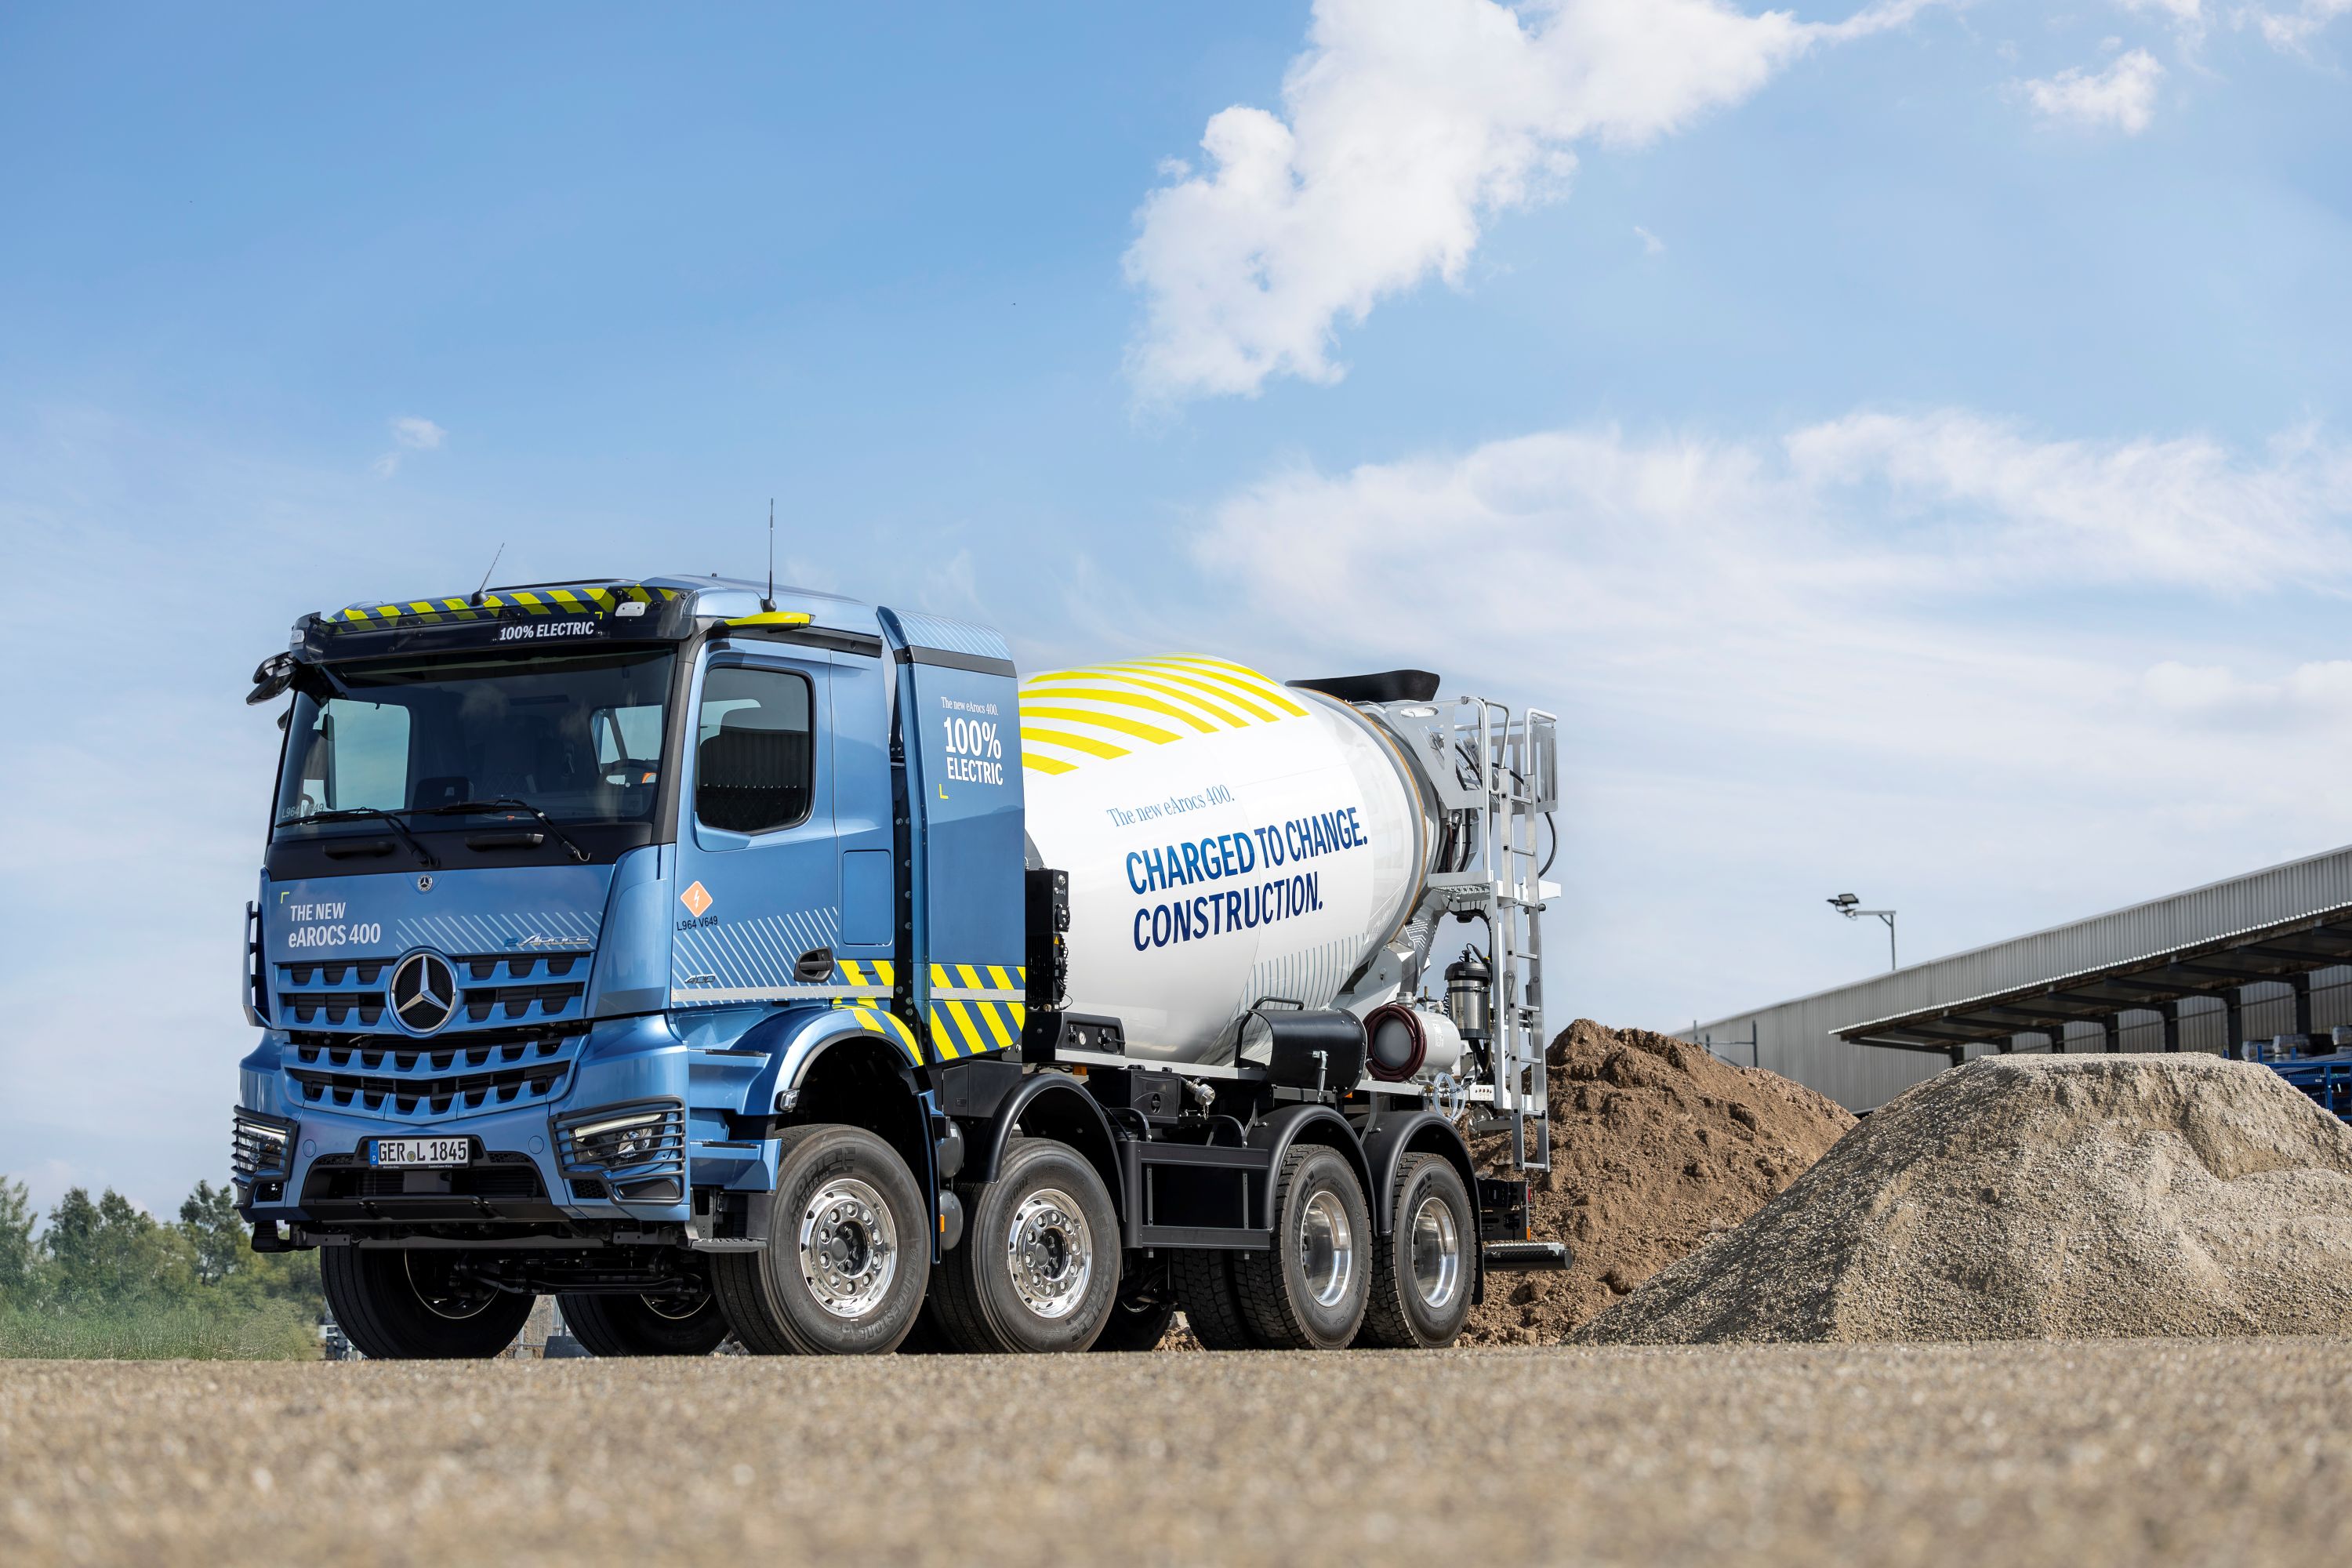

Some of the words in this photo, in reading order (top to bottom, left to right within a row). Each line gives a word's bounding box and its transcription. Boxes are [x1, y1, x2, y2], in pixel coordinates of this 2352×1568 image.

[499, 625, 534, 641] 100%
[536, 621, 594, 637] ELECTRIC
[940, 696, 953, 710] The
[953, 701, 966, 710] new
[966, 700, 985, 714] eArocs
[985, 703, 999, 716] 400.
[943, 717, 1002, 760] 100%
[946, 757, 1004, 786] ELECTRIC
[282, 806, 300, 818] L964
[1106, 808, 1136, 827] The
[1135, 804, 1162, 822] new
[1163, 797, 1206, 815] eArocs
[1206, 784, 1235, 806] 400.
[1126, 832, 1255, 895] CHARGED
[1254, 825, 1284, 869] TO
[1285, 807, 1368, 862] CHANGE.
[290, 904, 314, 922] THE
[315, 902, 347, 920] NEW
[676, 919, 697, 931] L964
[698, 915, 718, 927] V649
[1134, 871, 1323, 952] CONSTRUCTION.
[289, 924, 347, 948] eAROCS
[348, 923, 381, 945] 400
[379, 1142, 405, 1162] GER
[416, 1142, 426, 1161] L
[430, 1141, 466, 1160] 1845
